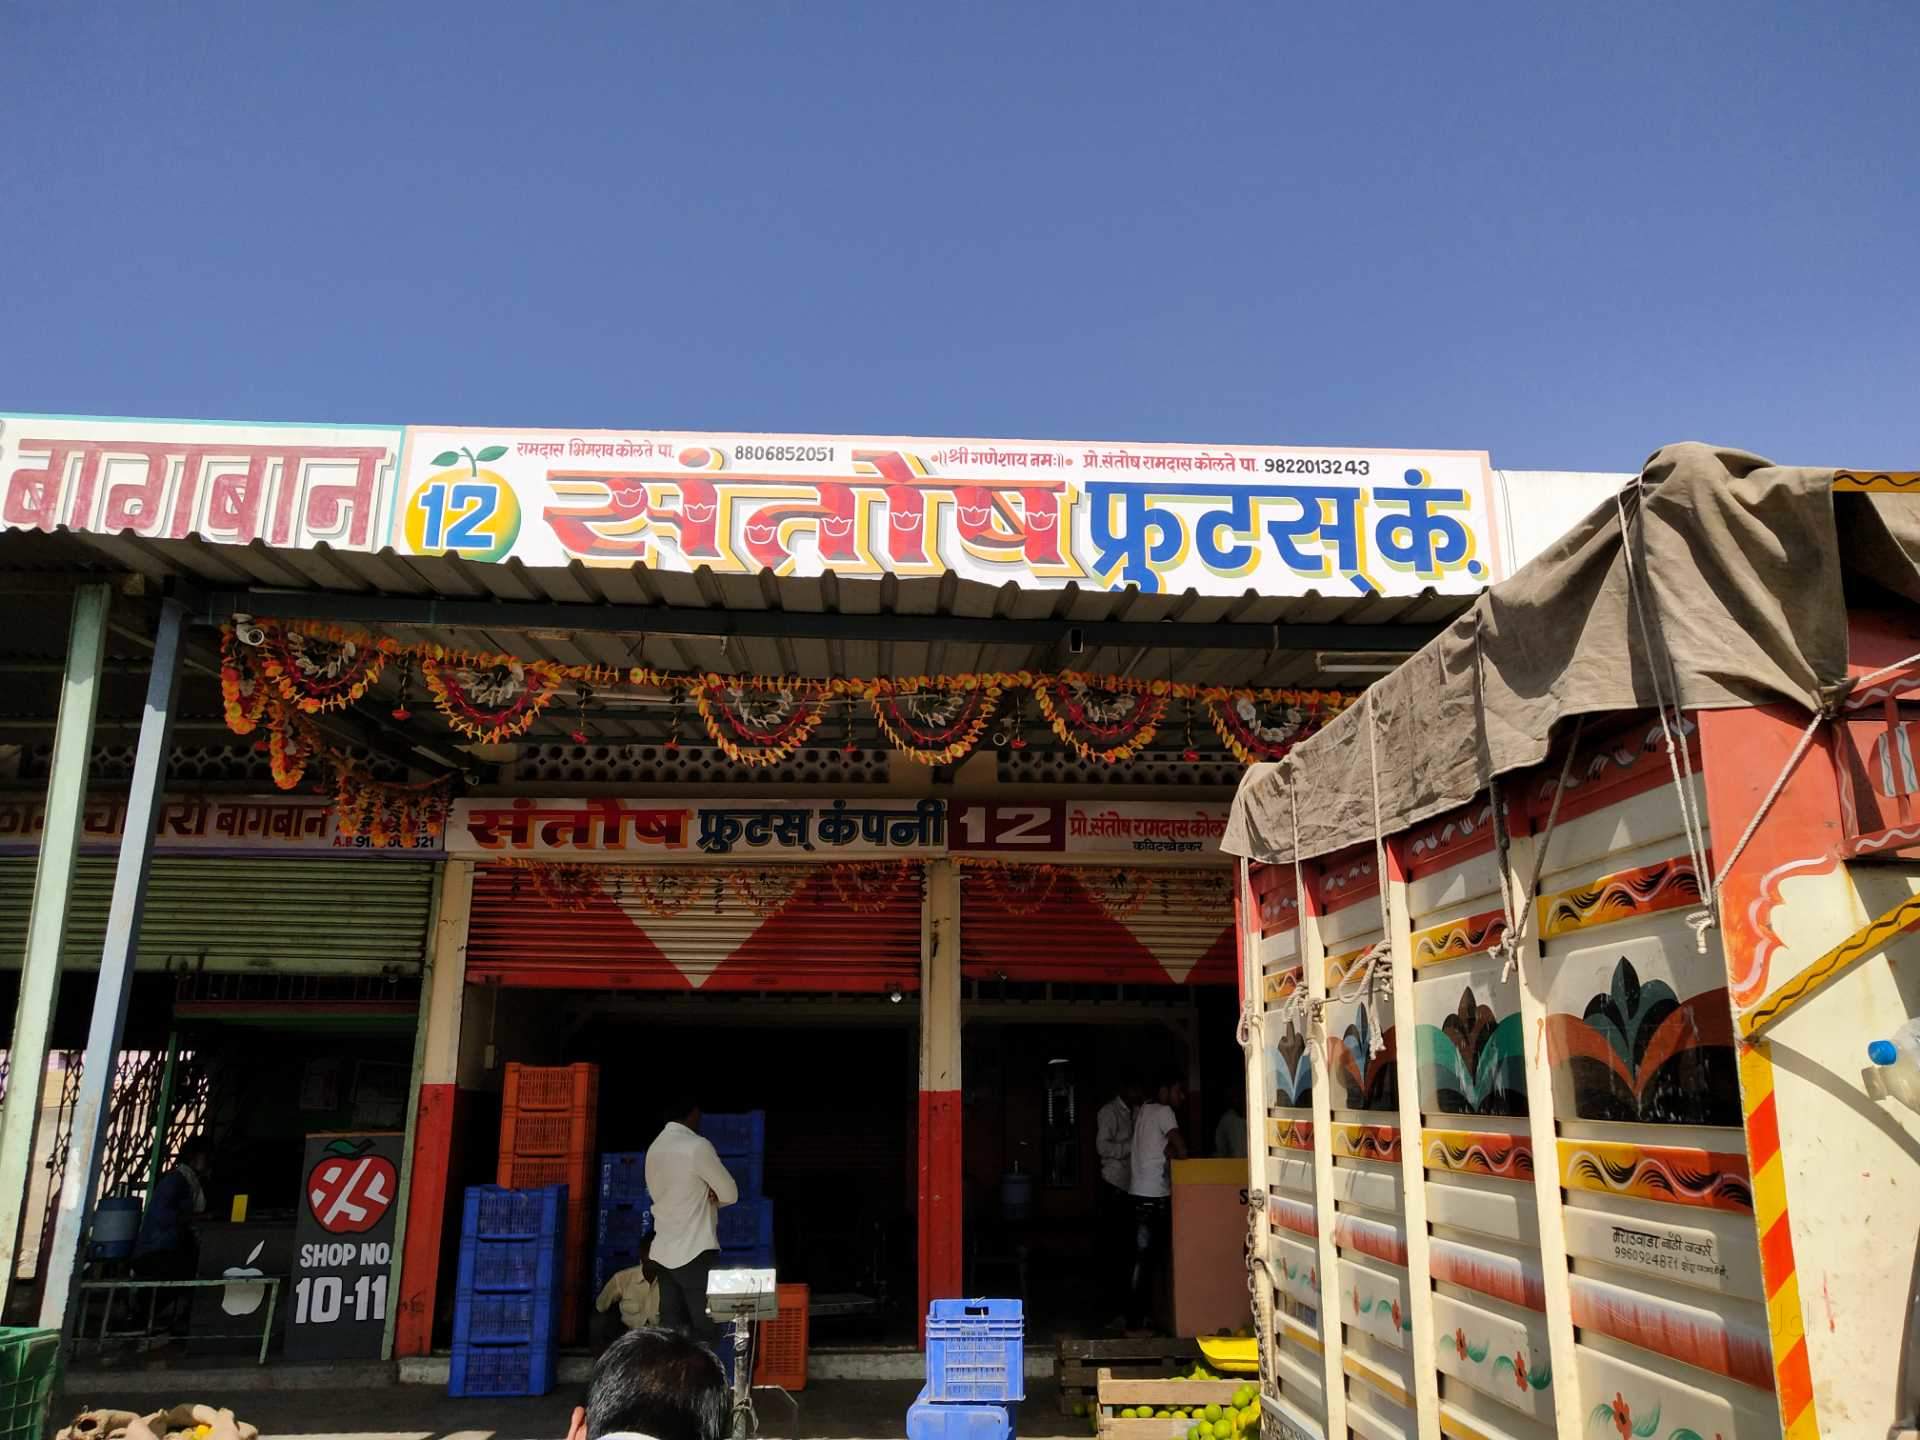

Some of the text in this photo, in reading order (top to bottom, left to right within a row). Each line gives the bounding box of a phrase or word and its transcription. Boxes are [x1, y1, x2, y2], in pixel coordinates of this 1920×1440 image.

[517, 442, 564, 459] रामदास
[735, 445, 835, 463] 8806852051
[971, 448, 1028, 467] गणेशाय
[1143, 455, 1192, 473] रामदास
[1195, 452, 1236, 472] कोलते
[1264, 457, 1370, 477] 9822013243
[420, 484, 498, 549] 12
[543, 447, 1070, 572] संतोष
[216, 804, 331, 839] बागबान
[467, 799, 694, 849] संतोष
[817, 799, 948, 847] कंपनी
[959, 806, 1052, 844] 12
[1134, 818, 1189, 839] रामदास
[1611, 1225, 1661, 1249] मराठवाडा
[300, 1242, 392, 1268] SHOP NO.
[295, 1274, 388, 1324] 10-11
